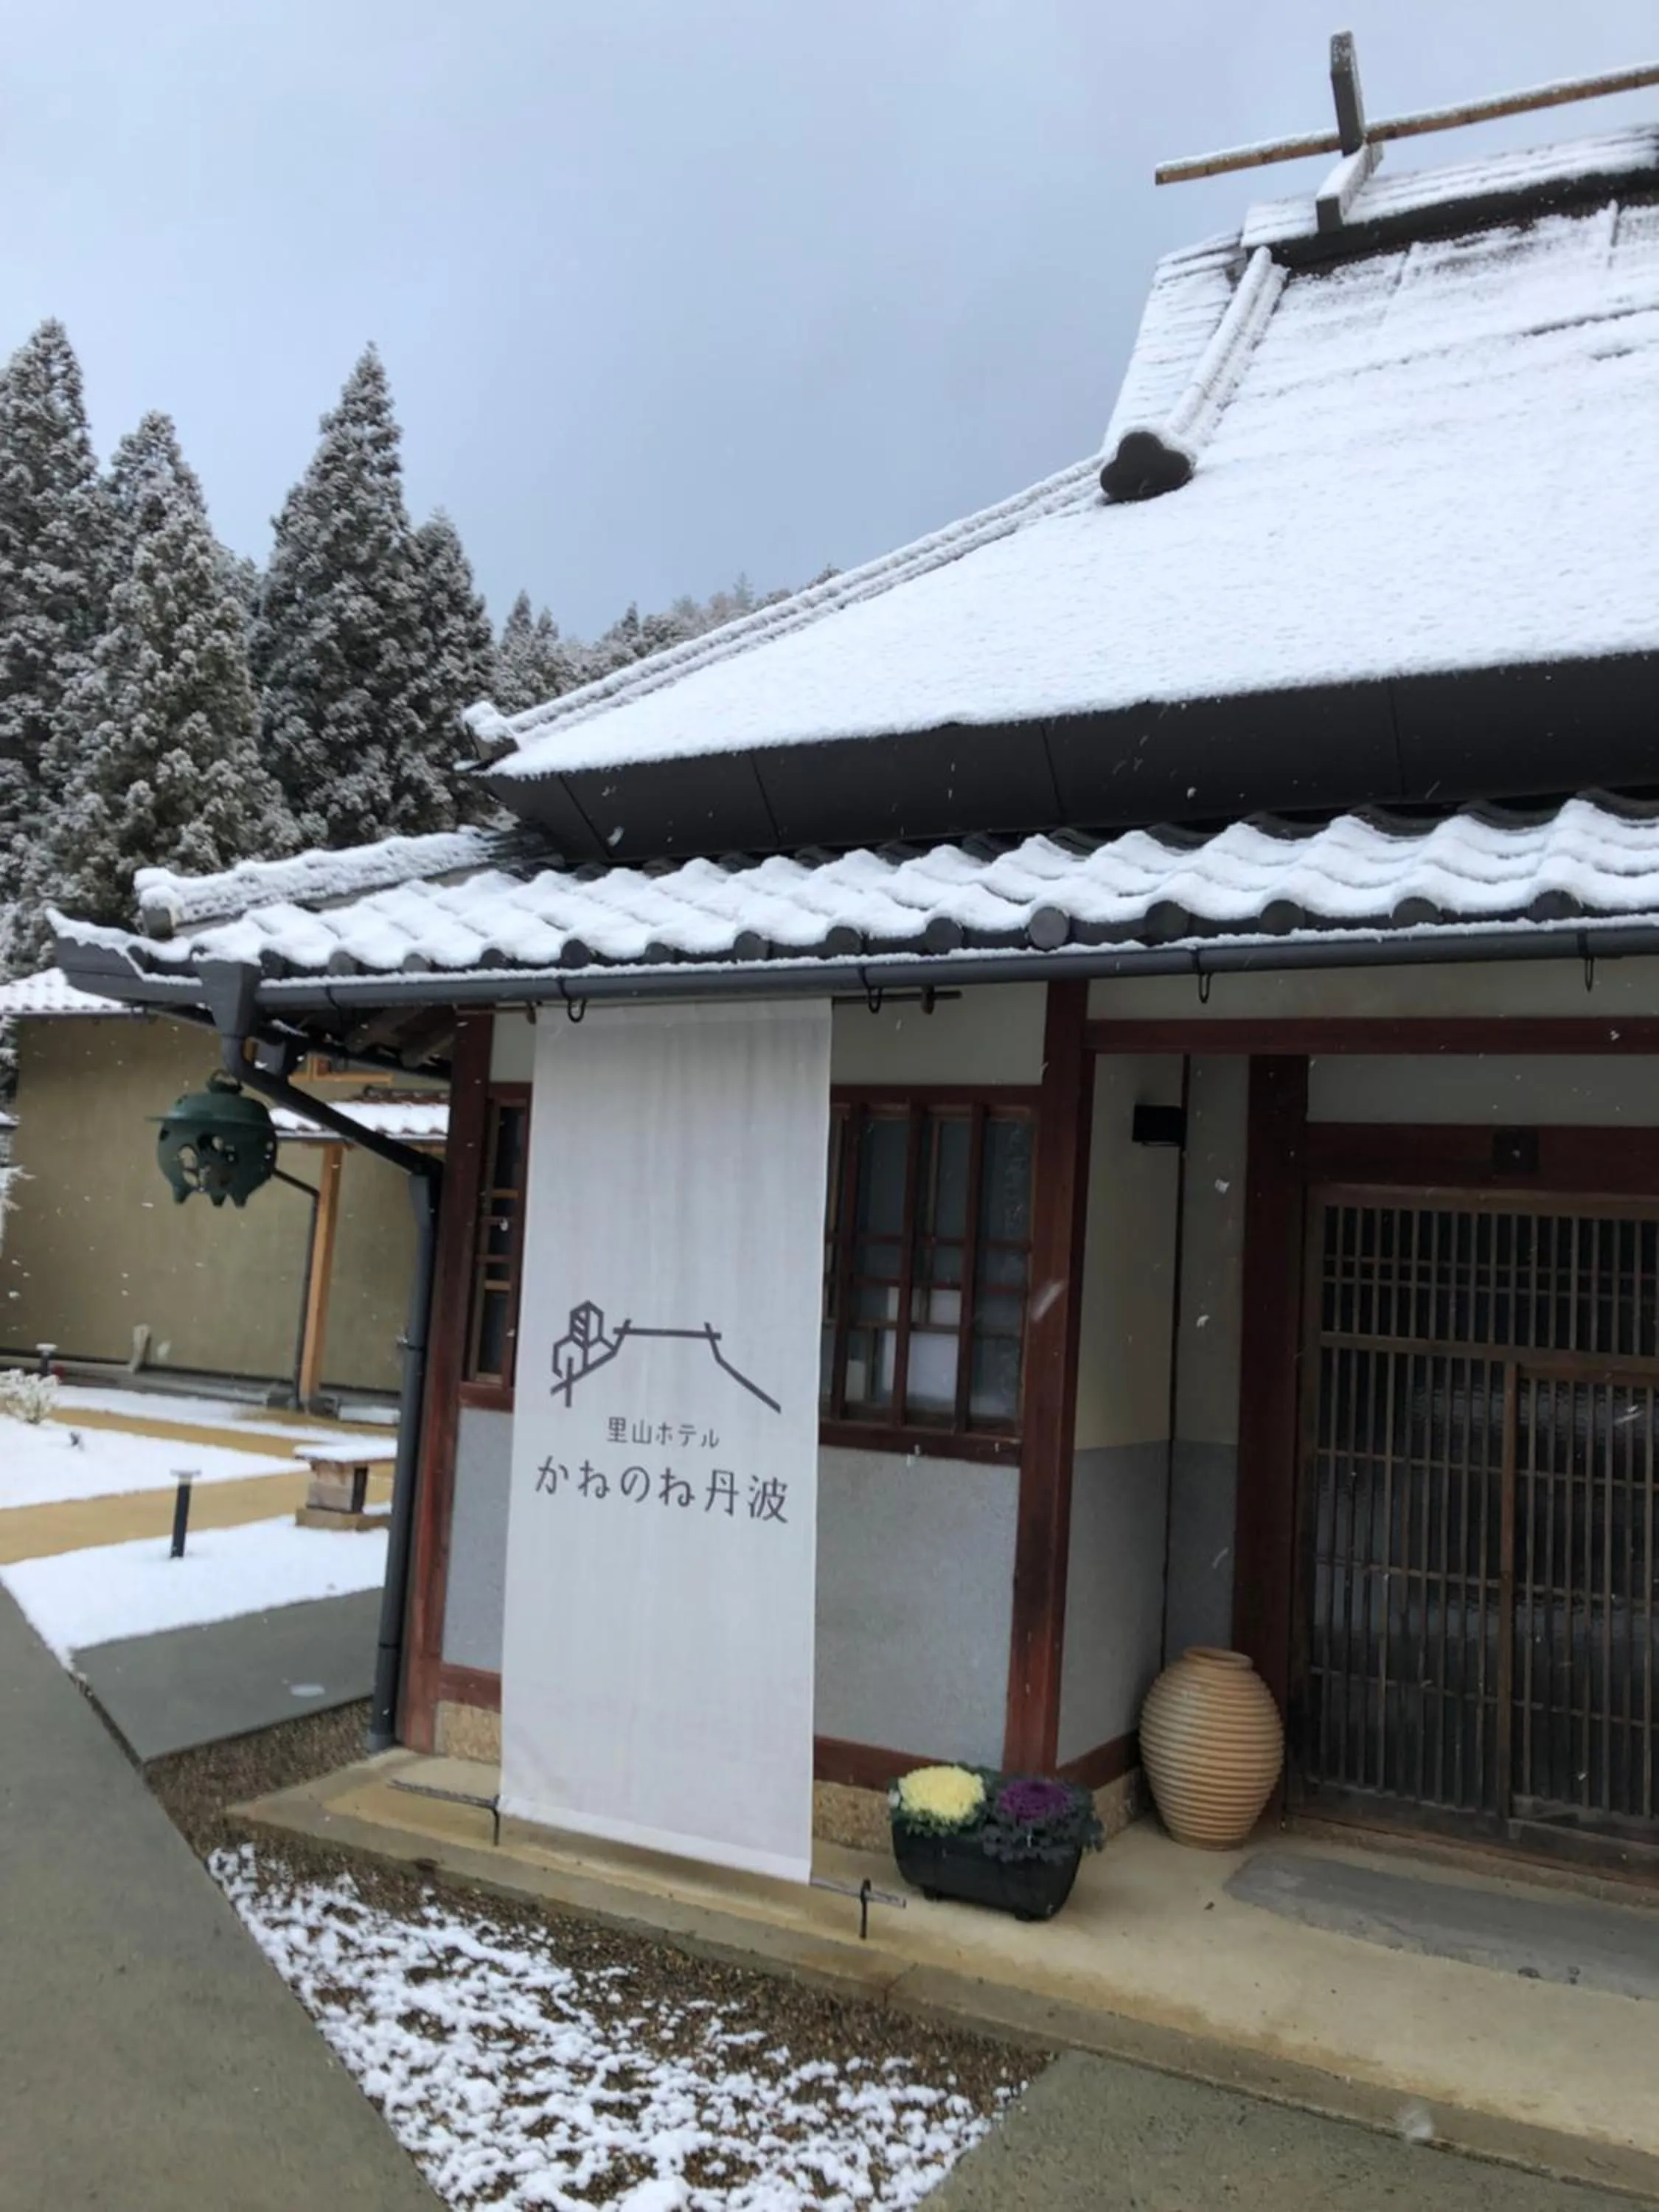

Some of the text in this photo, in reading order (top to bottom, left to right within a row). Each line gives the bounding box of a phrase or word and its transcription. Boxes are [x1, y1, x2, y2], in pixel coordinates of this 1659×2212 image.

[606, 1416, 720, 1448] 里山ホテル
[535, 1455, 788, 1523] かねのね丹波
